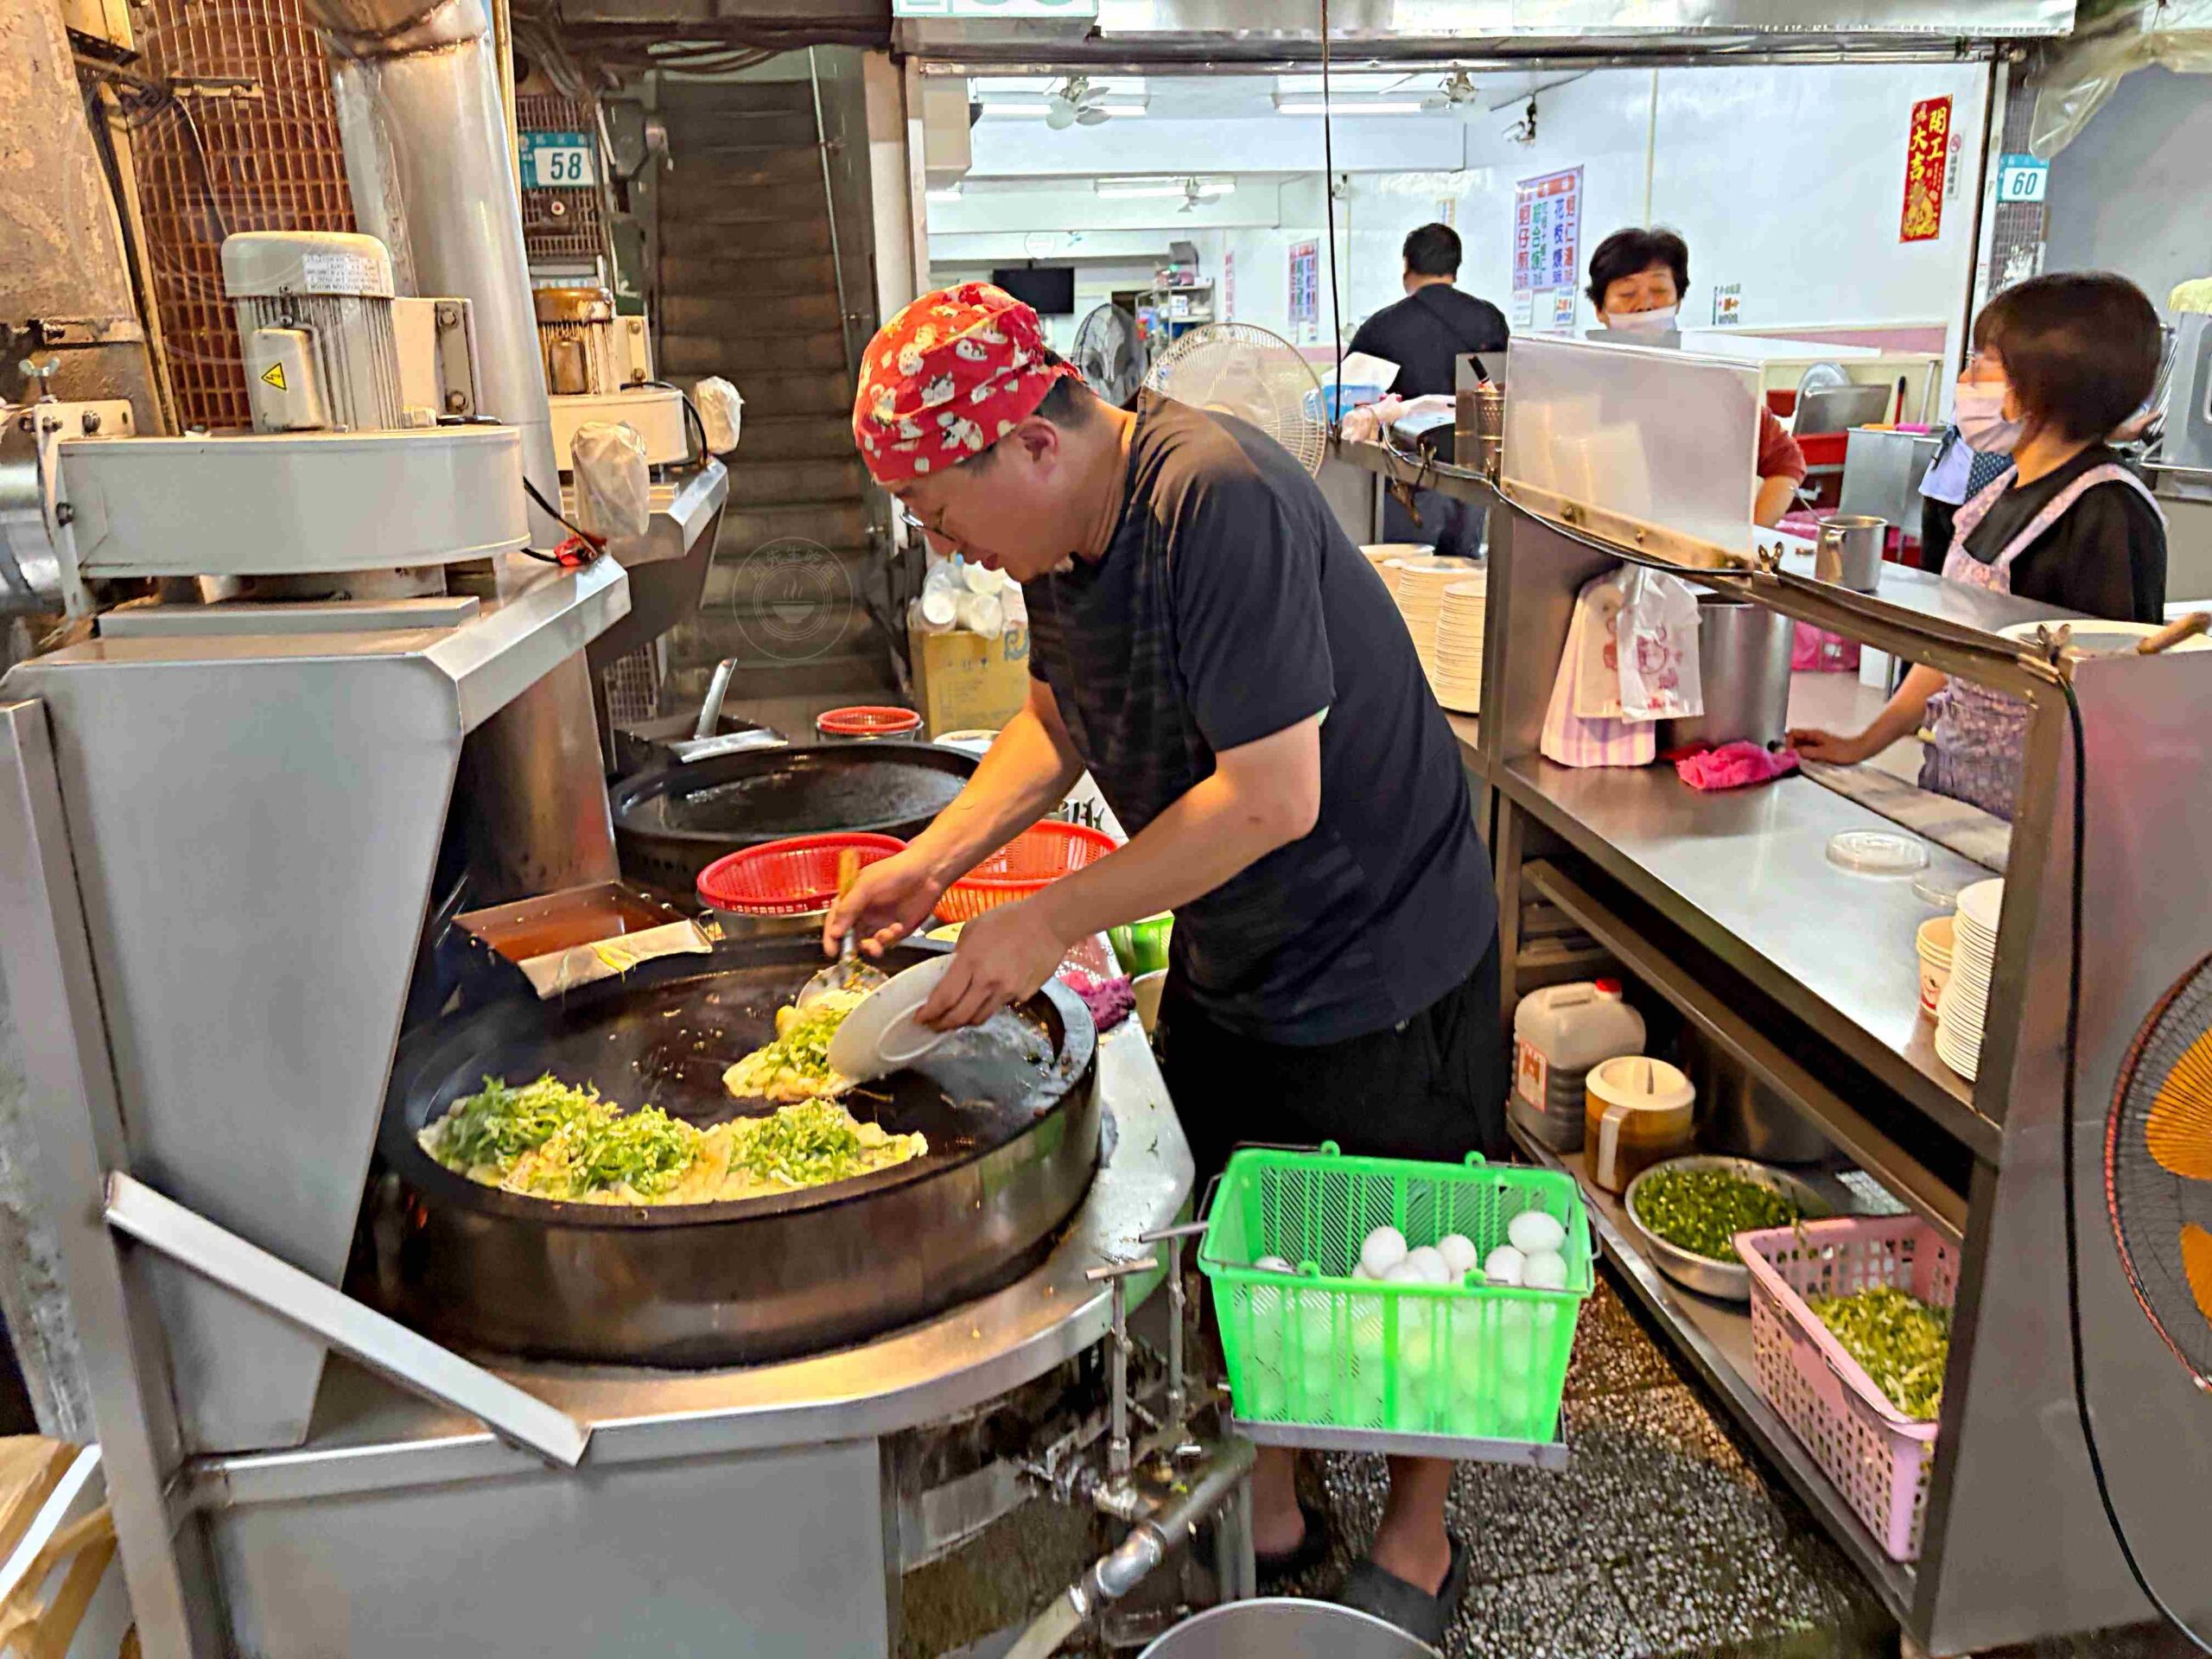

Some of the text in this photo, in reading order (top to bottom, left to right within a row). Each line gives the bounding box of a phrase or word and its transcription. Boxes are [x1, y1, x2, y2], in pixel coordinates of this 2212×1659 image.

[1909, 125, 1929, 181] 大吉
[1927, 107, 1947, 162] 開工
[550, 152, 582, 180] 58
[2012, 172, 2037, 195] 60
